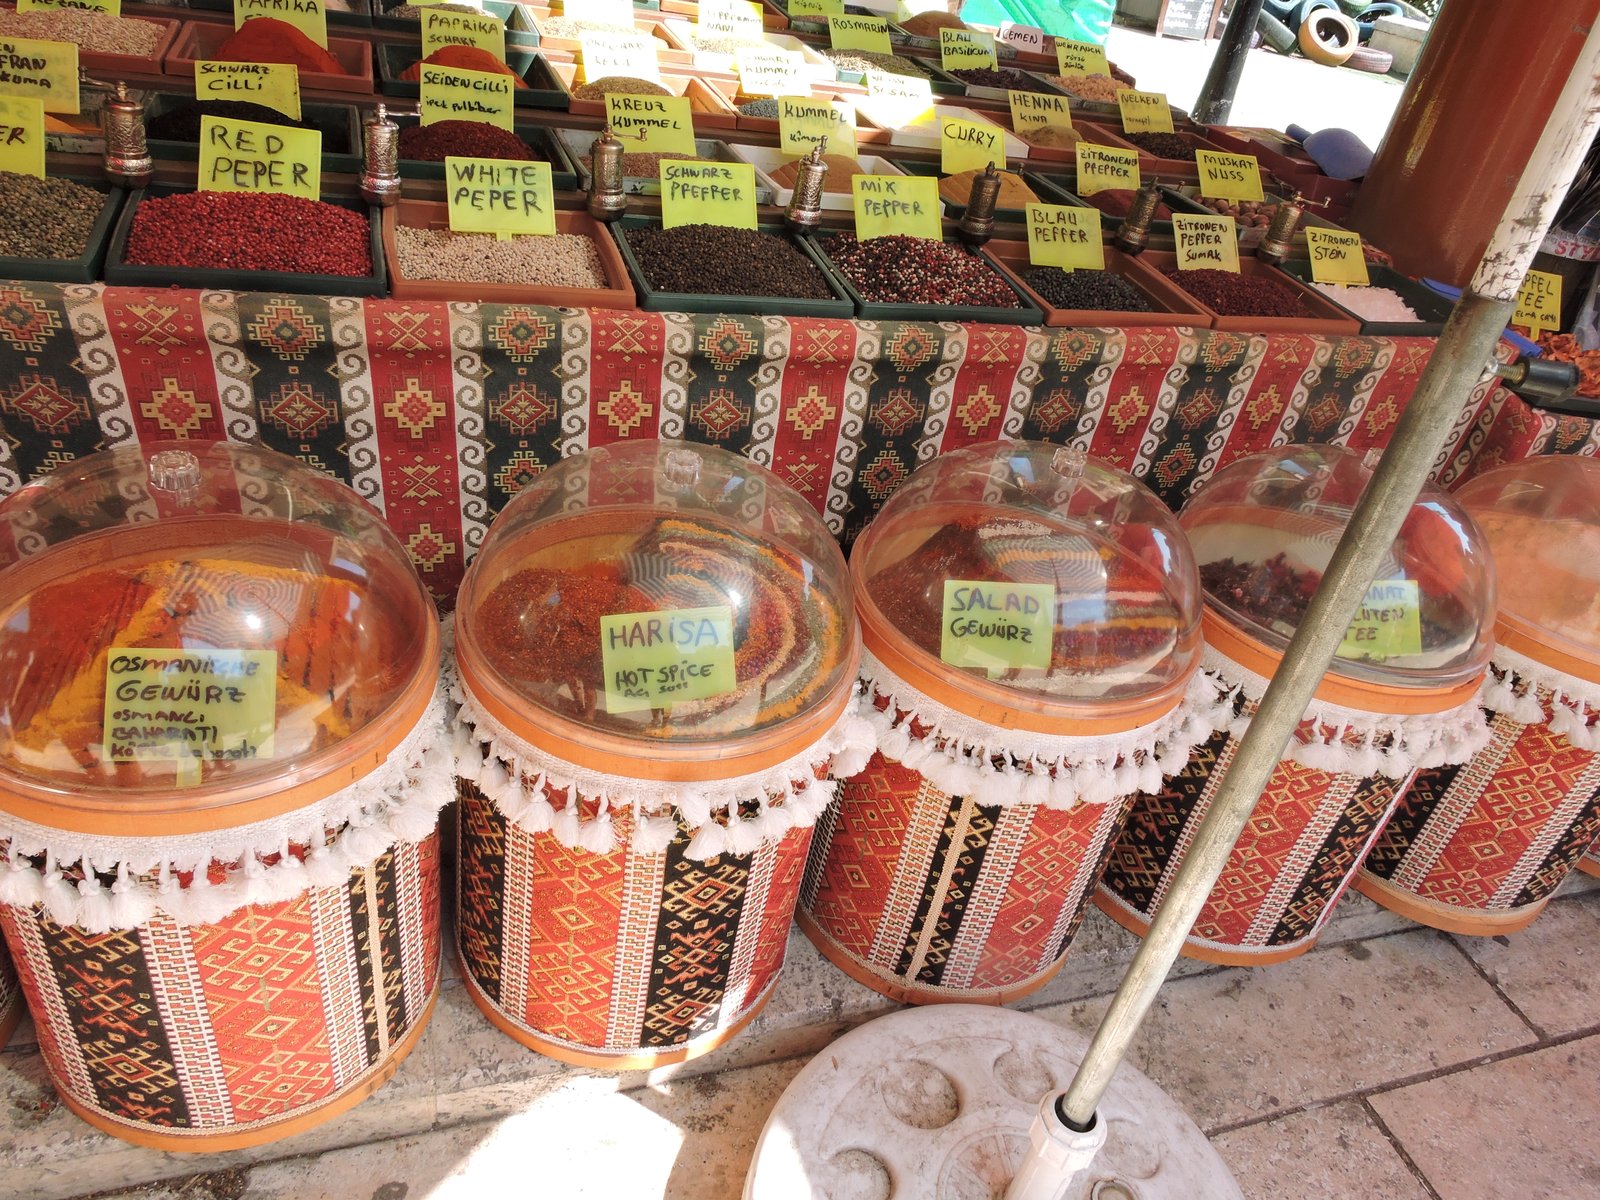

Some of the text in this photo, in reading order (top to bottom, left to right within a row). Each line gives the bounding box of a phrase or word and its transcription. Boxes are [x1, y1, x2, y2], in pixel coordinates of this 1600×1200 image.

[240, 0, 318, 14] PAPRIKA
[428, 14, 498, 35] PAPRIKA
[943, 31, 971, 43] BLAU
[200, 63, 271, 76] SCHWARZ
[612, 97, 668, 113] KREUZ
[1013, 93, 1064, 113] HENNA
[1121, 93, 1160, 105] NELKEN
[784, 101, 847, 123] KUMMEL
[210, 125, 284, 154] RED
[944, 123, 995, 149] CURRY
[1203, 155, 1255, 170] MUSKAT
[212, 156, 312, 189] PEPER
[452, 163, 538, 187] WHITE
[664, 165, 734, 181] SCHWARZ
[1208, 168, 1245, 182] NUSS
[861, 177, 897, 196] MiX
[453, 189, 544, 217] PEPER
[864, 199, 924, 218] PEPPER
[1032, 208, 1078, 226] BLAU
[1185, 249, 1222, 262] SUMAK
[1521, 273, 1554, 296] PFEL
[1517, 290, 1545, 309] TEE
[950, 587, 1040, 615] SALAD
[950, 616, 1033, 644] GEWÜRZ
[1344, 626, 1379, 641] TEE
[615, 667, 655, 691] HOT
[115, 679, 246, 705] GEWÜRZ
